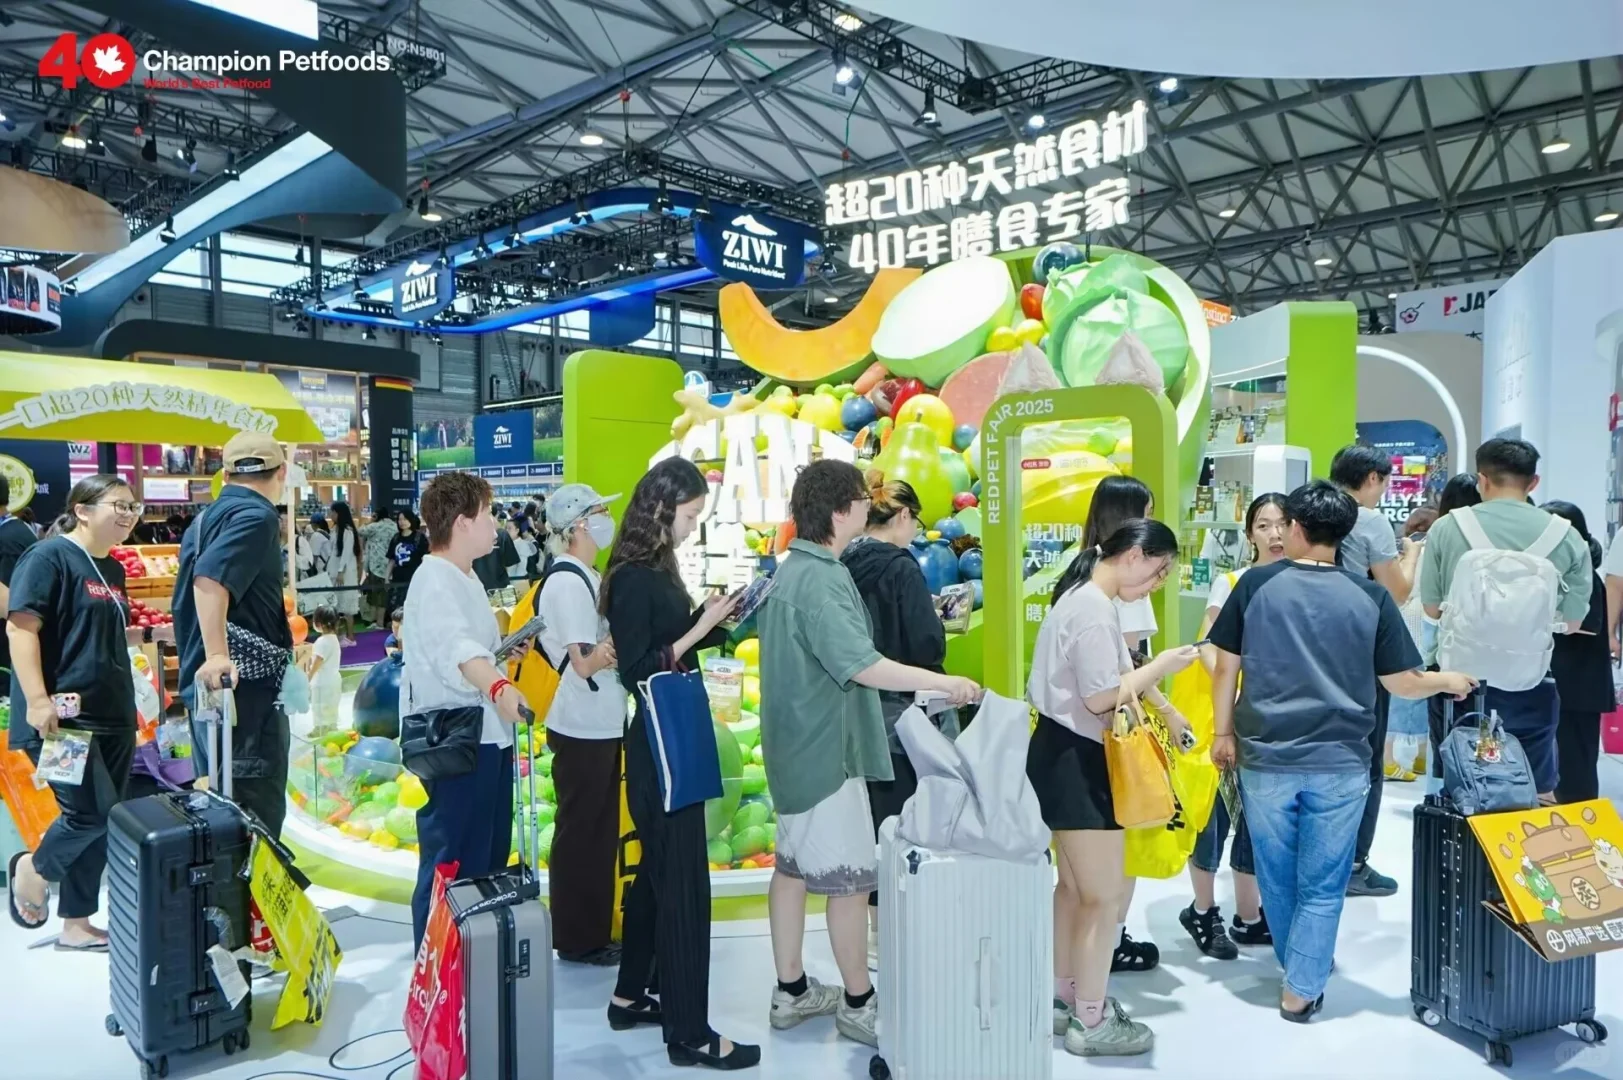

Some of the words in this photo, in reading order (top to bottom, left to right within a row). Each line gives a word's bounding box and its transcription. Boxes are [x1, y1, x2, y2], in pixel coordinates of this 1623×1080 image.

[824, 99, 1148, 226] 超20种天然食材
[848, 177, 1131, 274] 40年膳食专家
[721, 229, 784, 269] ZIWI
[401, 272, 438, 305] ZIWI
[493, 432, 512, 446] ZIWI
[987, 403, 1013, 444] FAIR
[1015, 398, 1054, 417] 2025
[1375, 493, 1427, 507] LLY+
[1025, 522, 1083, 543] 超20种
